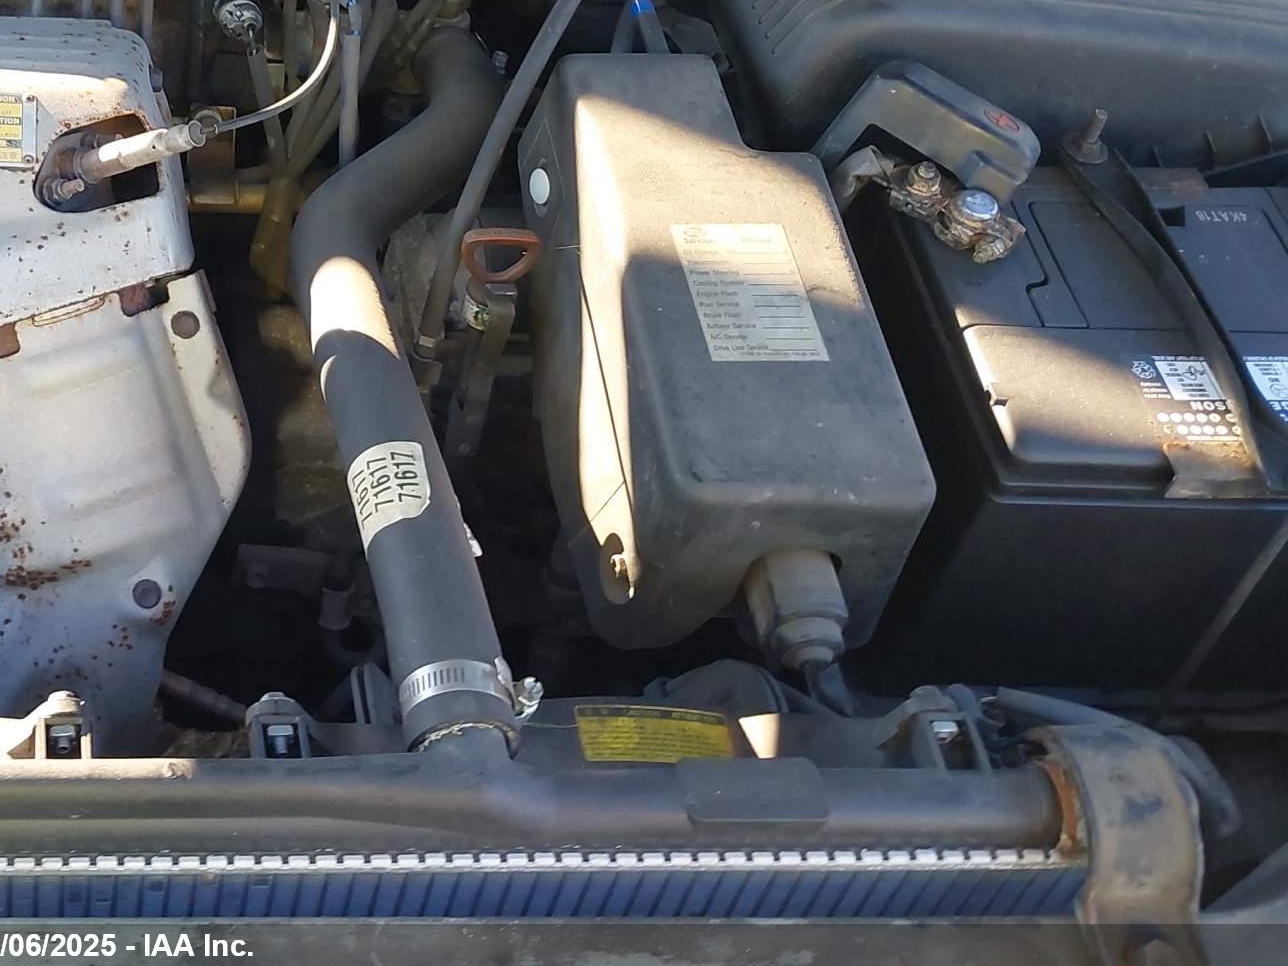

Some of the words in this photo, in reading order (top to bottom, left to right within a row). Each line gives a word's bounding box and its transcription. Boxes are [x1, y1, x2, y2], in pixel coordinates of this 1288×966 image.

[351, 469, 373, 531] 71617
[366, 457, 395, 513] 71617
[389, 451, 423, 503] 71617
